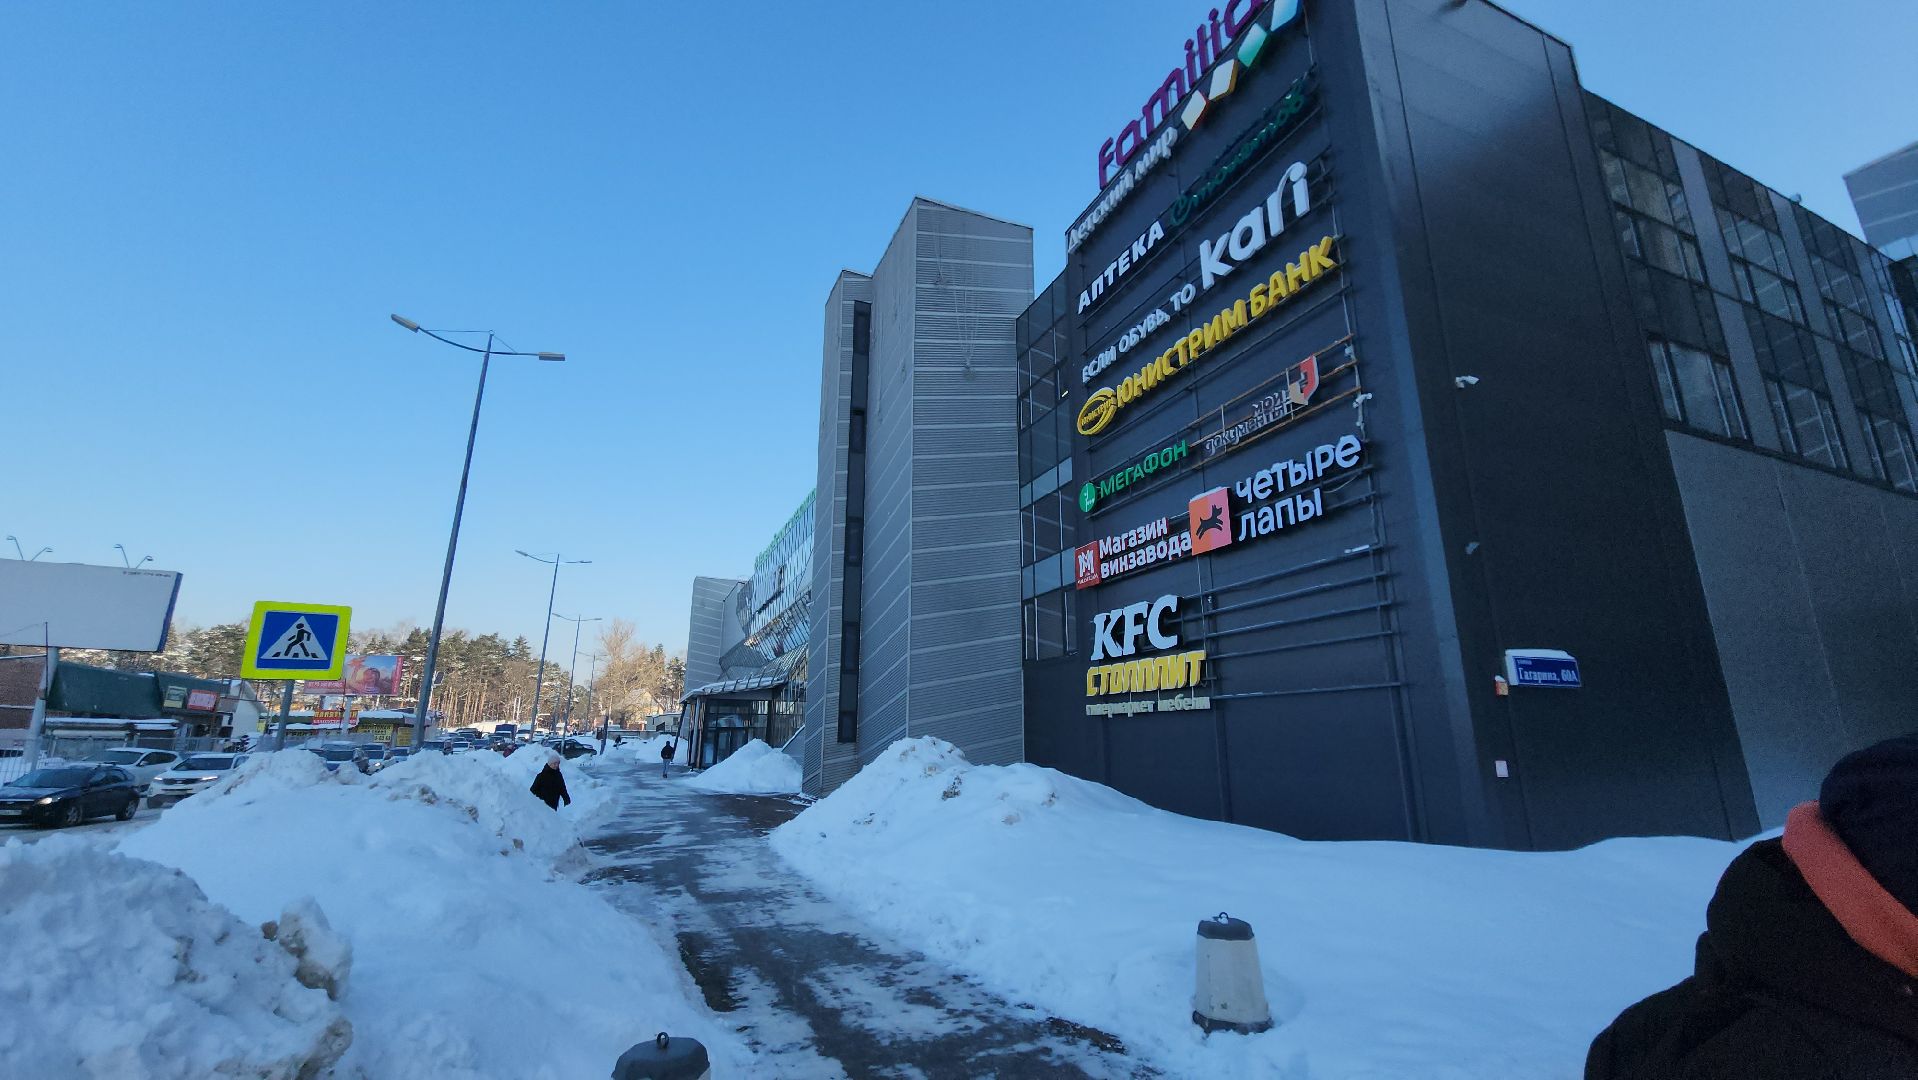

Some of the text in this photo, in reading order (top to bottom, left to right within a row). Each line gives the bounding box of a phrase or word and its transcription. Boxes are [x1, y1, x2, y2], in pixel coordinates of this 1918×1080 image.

[1068, 126, 1178, 254] Детский мир
[1199, 161, 1311, 291] kari
[1077, 220, 1165, 315] АПТЕКА
[1082, 345, 1117, 383] ЕСЛИ
[1169, 283, 1197, 312] ТО
[1116, 236, 1338, 408] ЮНИСТРИМ БАНК
[1100, 439, 1187, 499] МЕГАФОН
[1099, 517, 1167, 560] Магазин
[1100, 531, 1192, 579] винзавода
[1090, 594, 1178, 661] KFC
[1086, 650, 1206, 697] СТОЛПЛИТ
